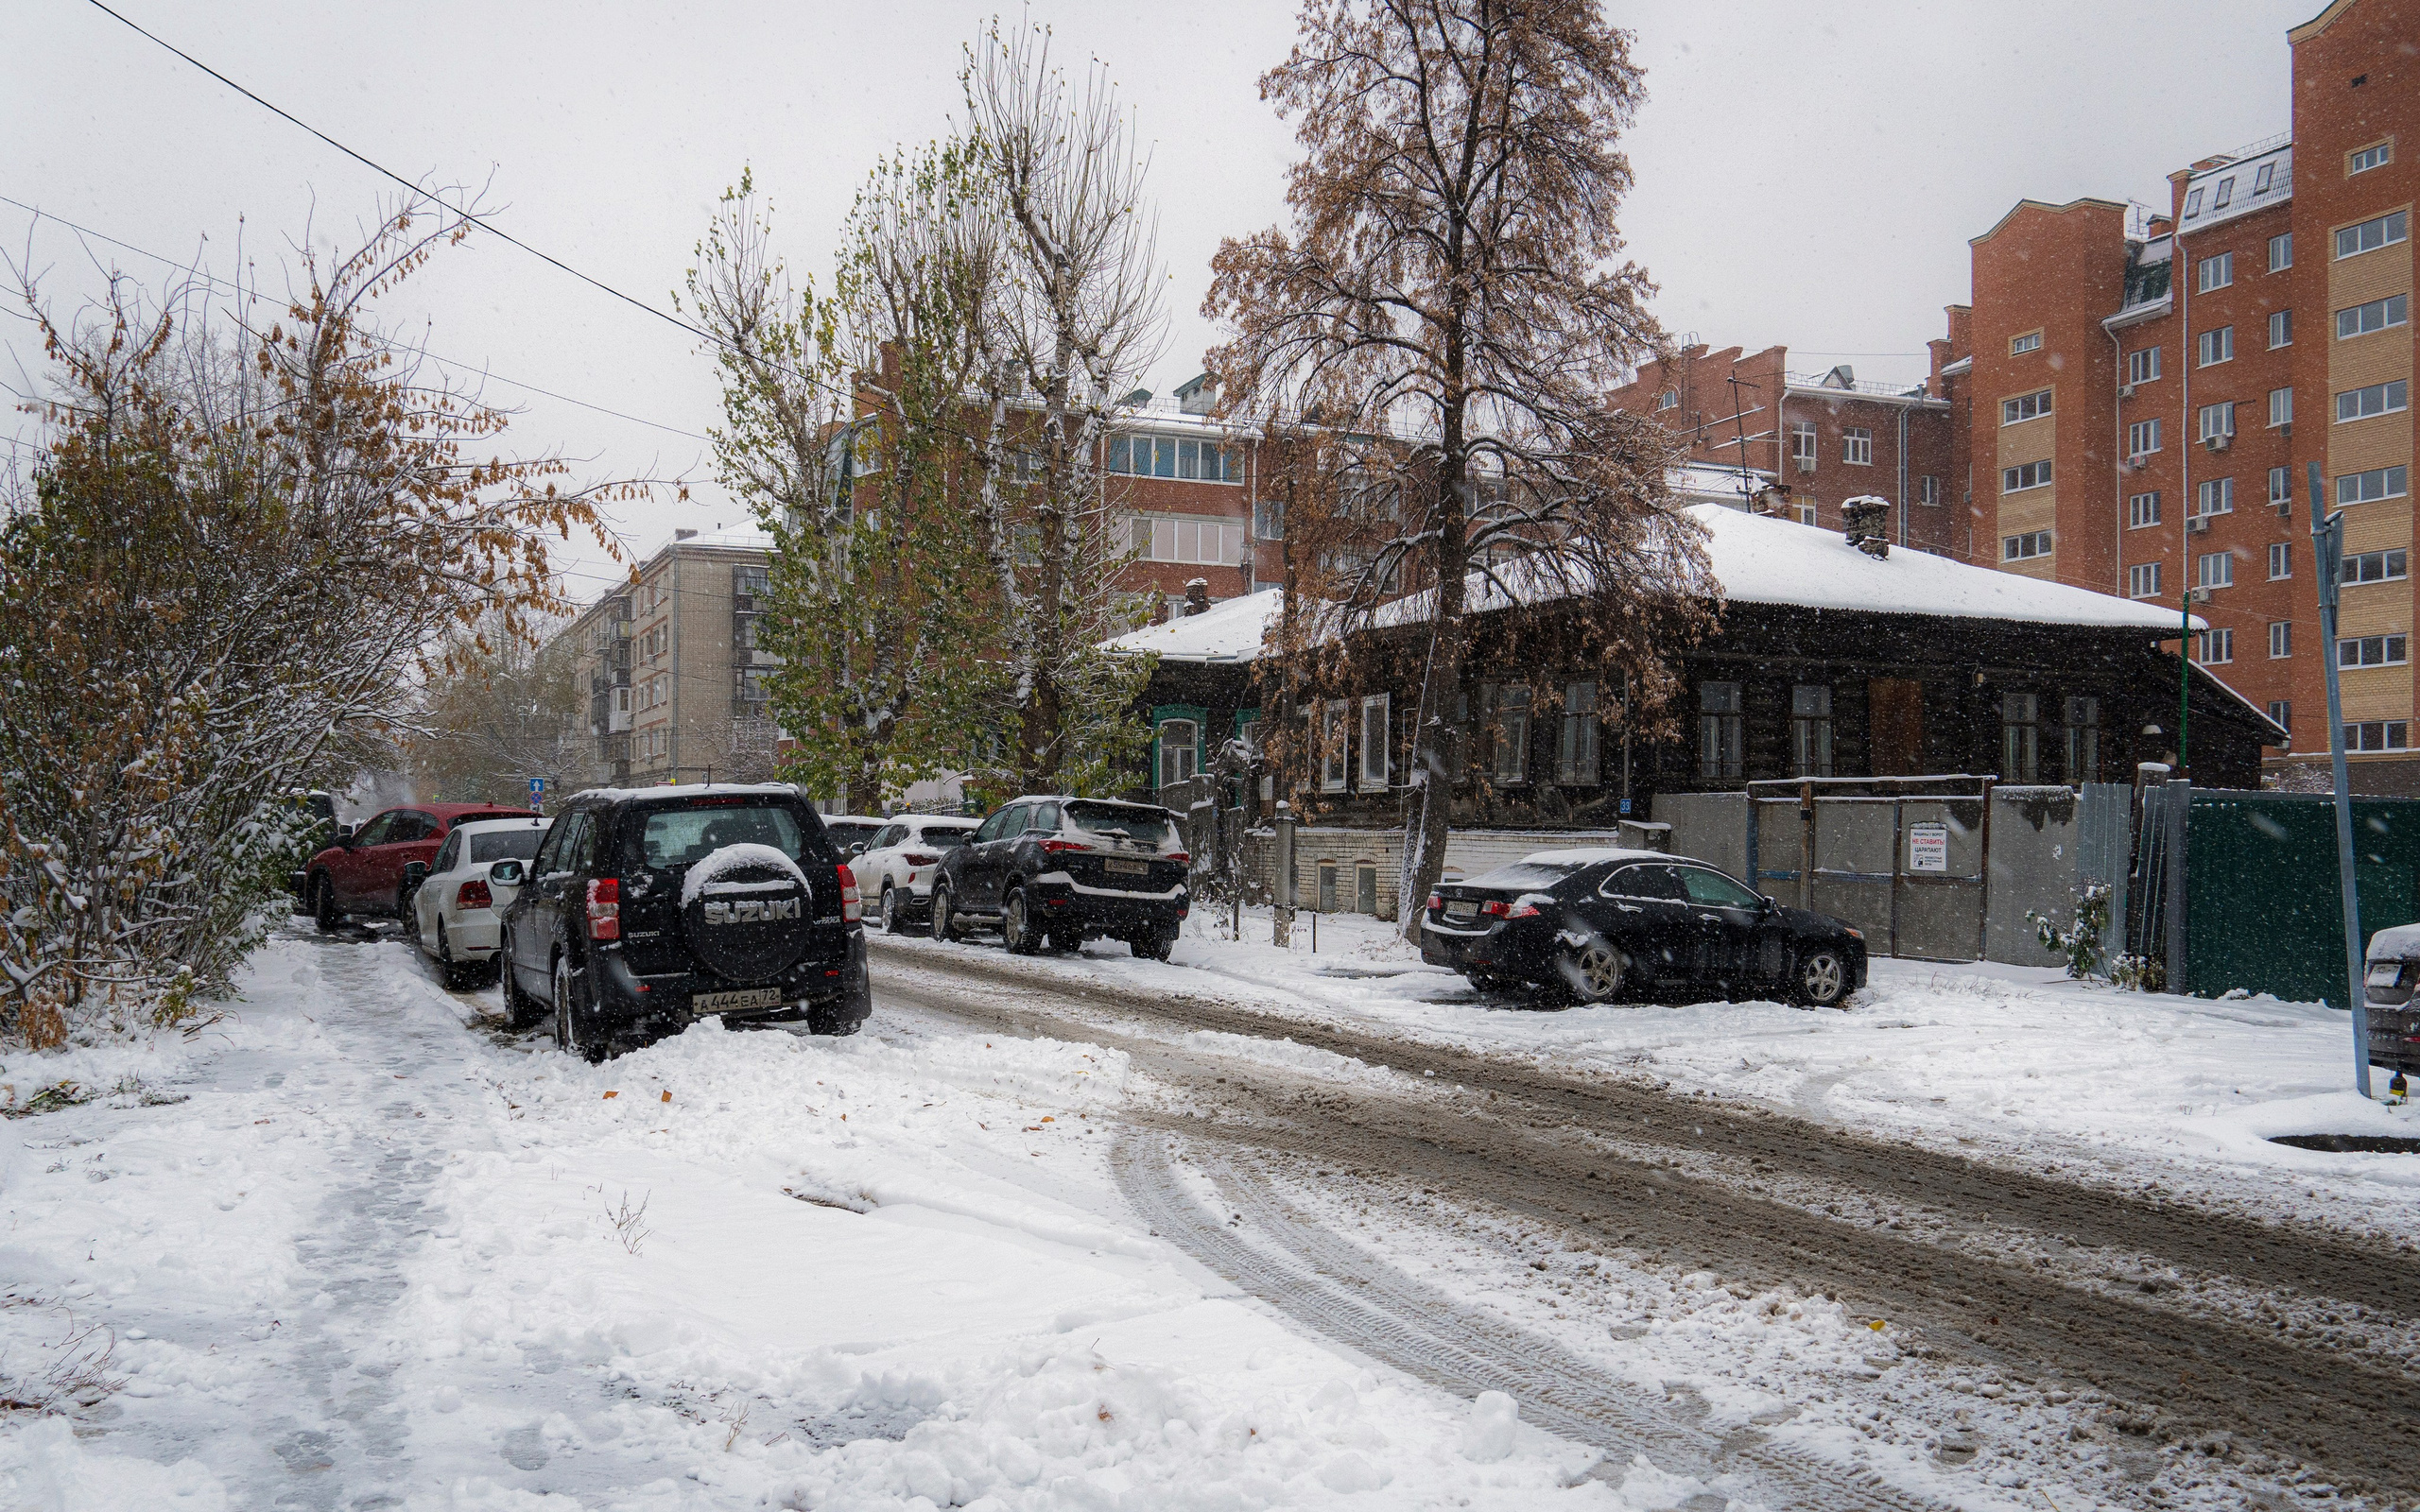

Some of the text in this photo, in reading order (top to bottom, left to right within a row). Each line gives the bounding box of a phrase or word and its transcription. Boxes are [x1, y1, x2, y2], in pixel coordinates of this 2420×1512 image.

[1621, 800, 1630, 811] 33
[704, 898, 801, 924] SUZUKI
[700, 989, 776, 1011] А444ЕА 72
